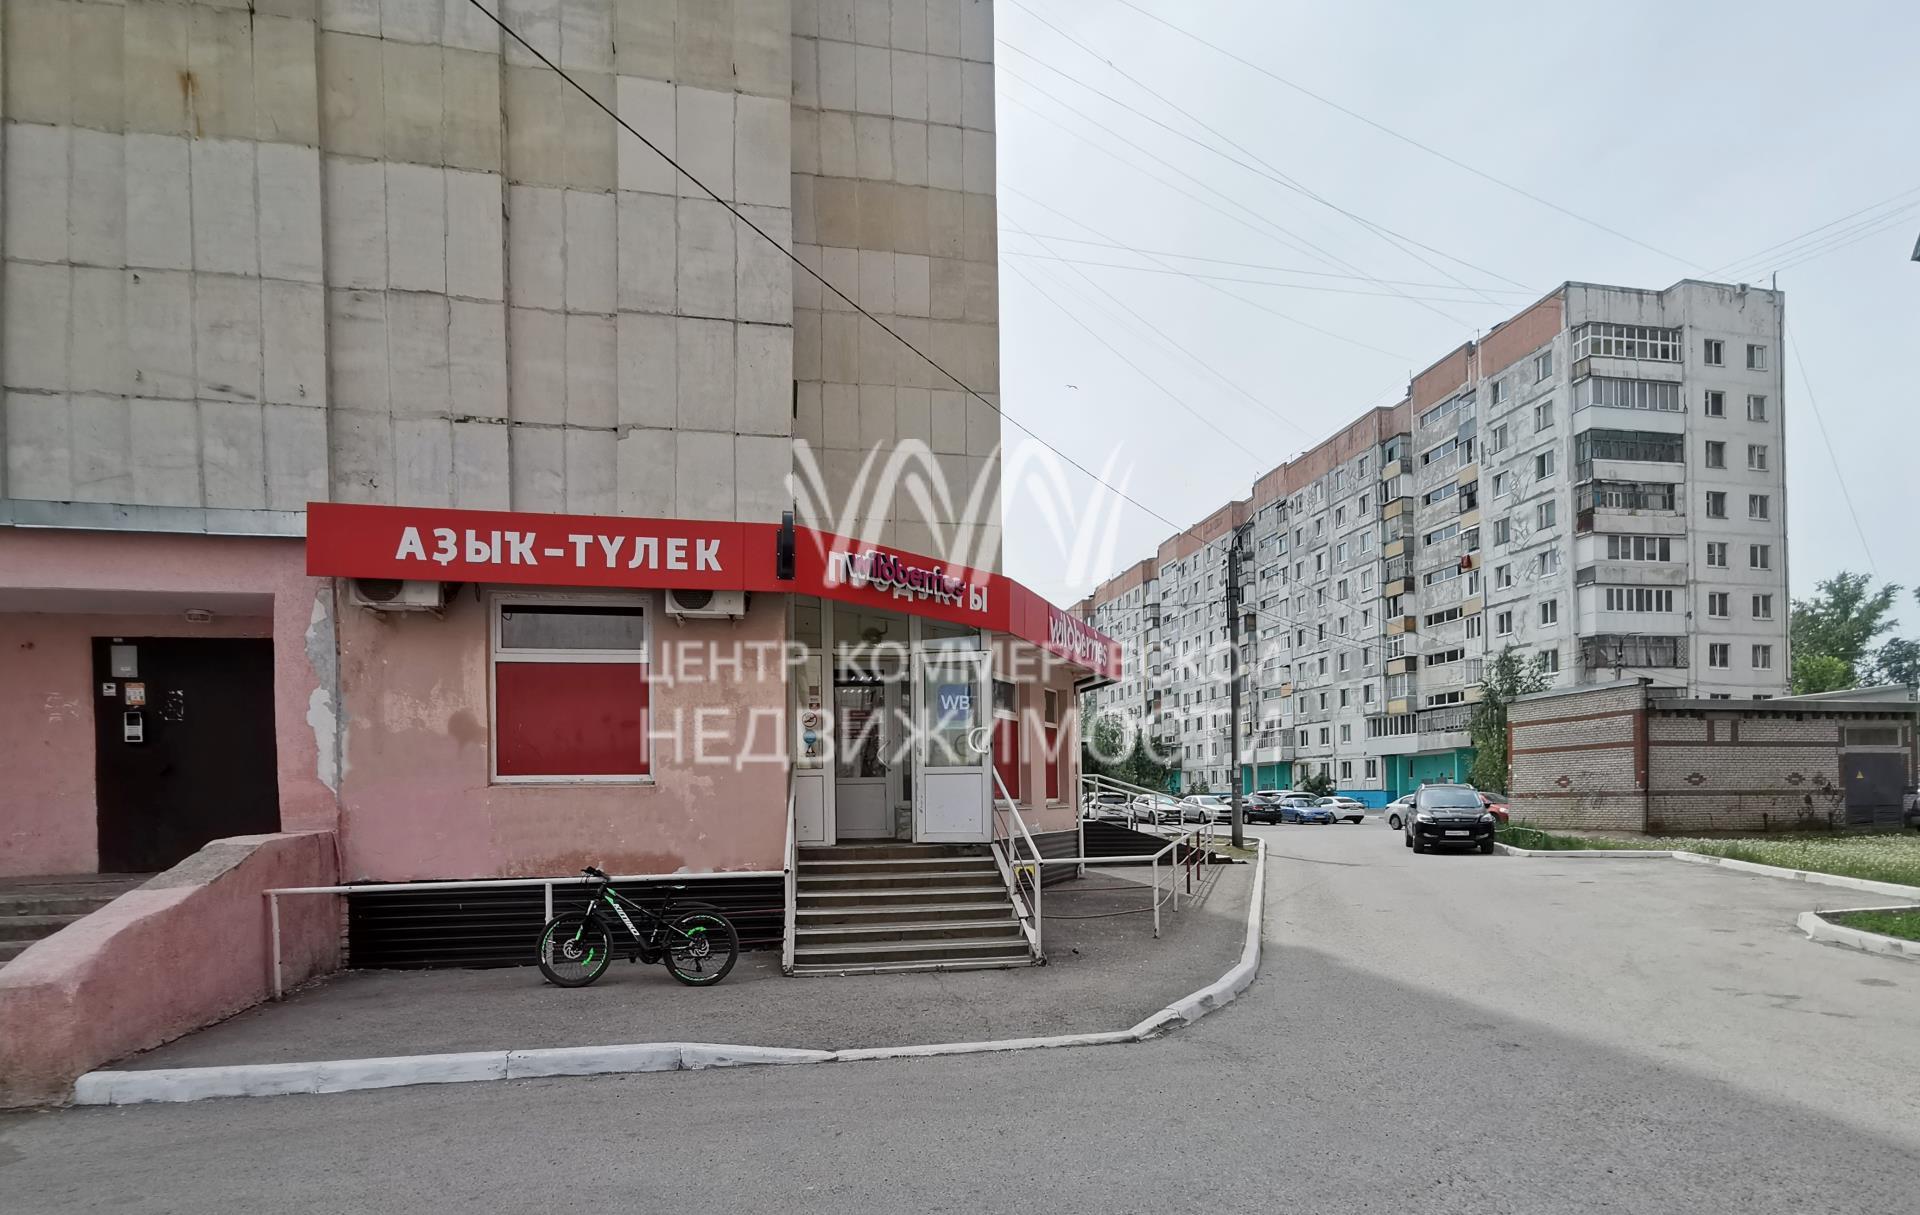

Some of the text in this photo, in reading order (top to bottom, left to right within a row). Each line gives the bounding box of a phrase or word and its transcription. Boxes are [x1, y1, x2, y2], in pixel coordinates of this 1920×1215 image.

[844, 549, 966, 599] wildberries
[1049, 612, 1108, 667] wildberries
[940, 694, 970, 710] WB
